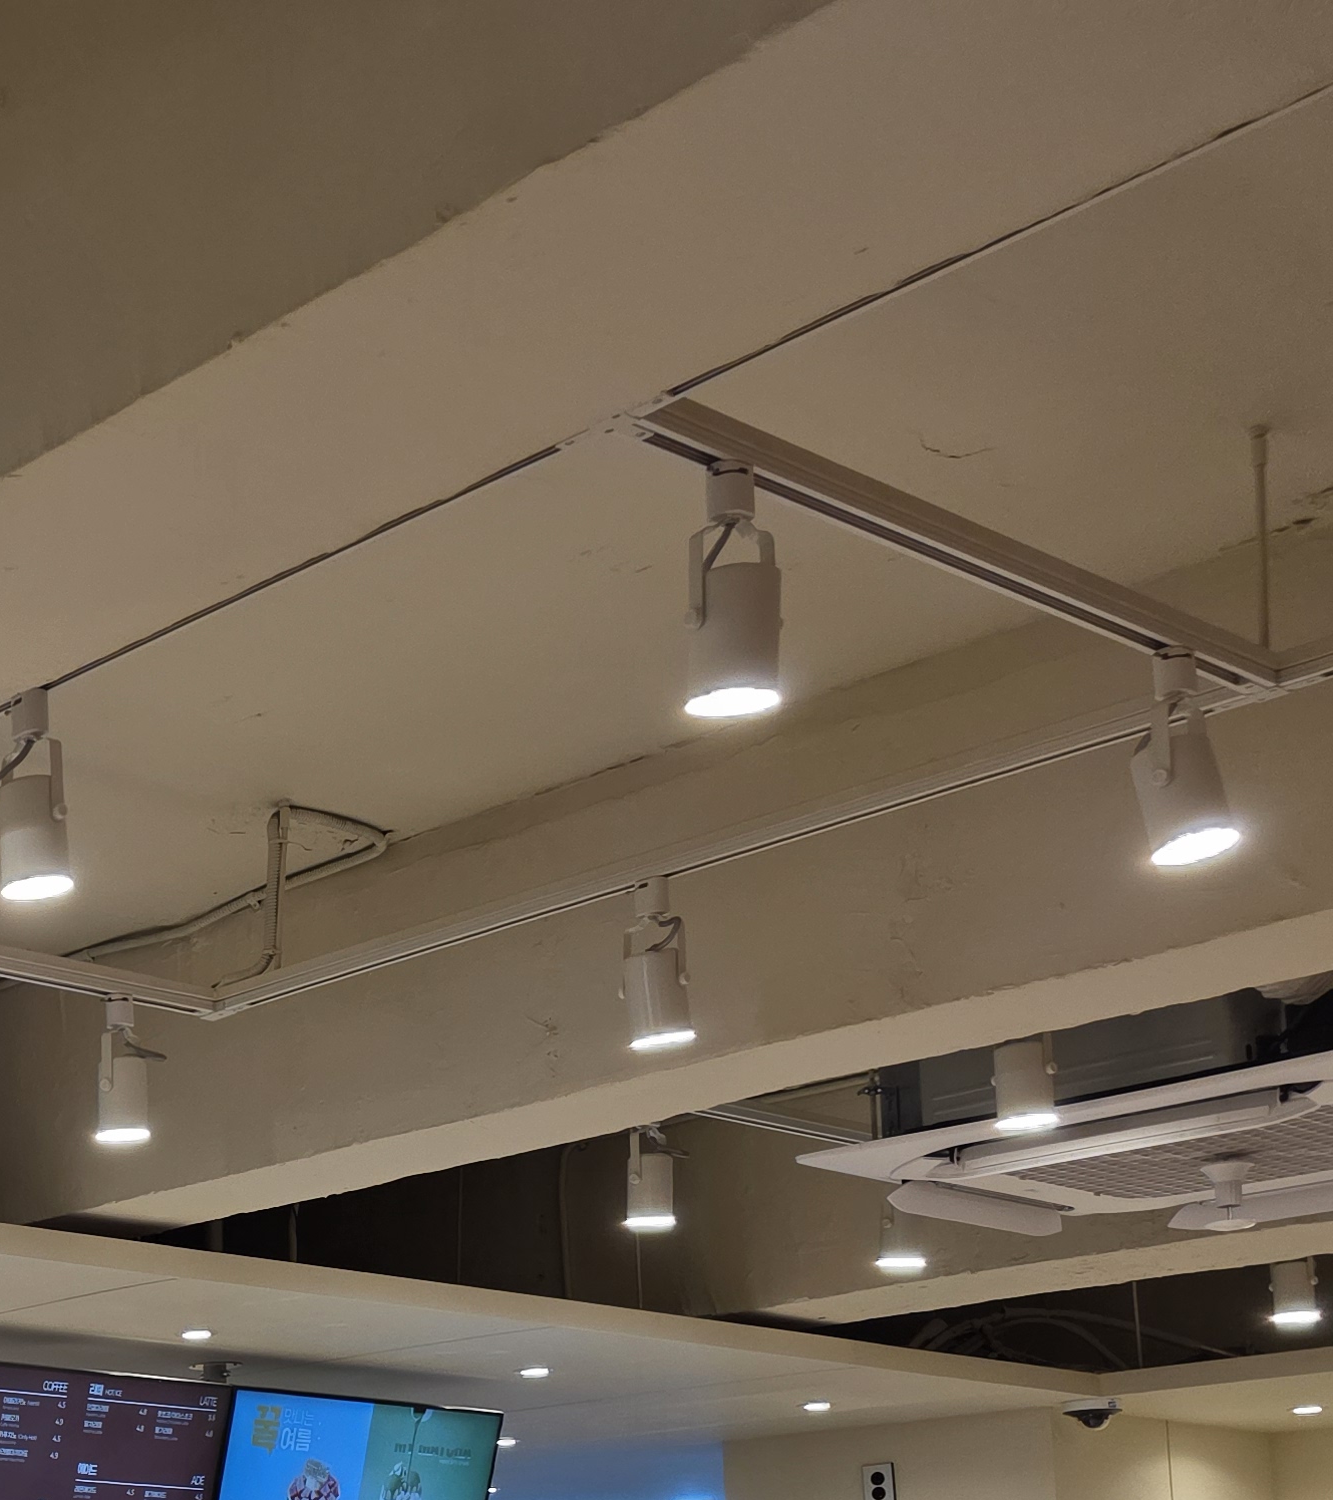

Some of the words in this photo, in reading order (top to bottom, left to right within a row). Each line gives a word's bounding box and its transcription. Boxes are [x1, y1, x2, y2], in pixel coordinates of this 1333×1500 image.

[42, 1380, 69, 1393] COFFEE
[199, 1396, 218, 1407] LATTE
[283, 1408, 314, 1427] 맛나는
[280, 1427, 312, 1452] 여름
[190, 1475, 205, 1486] ADE
